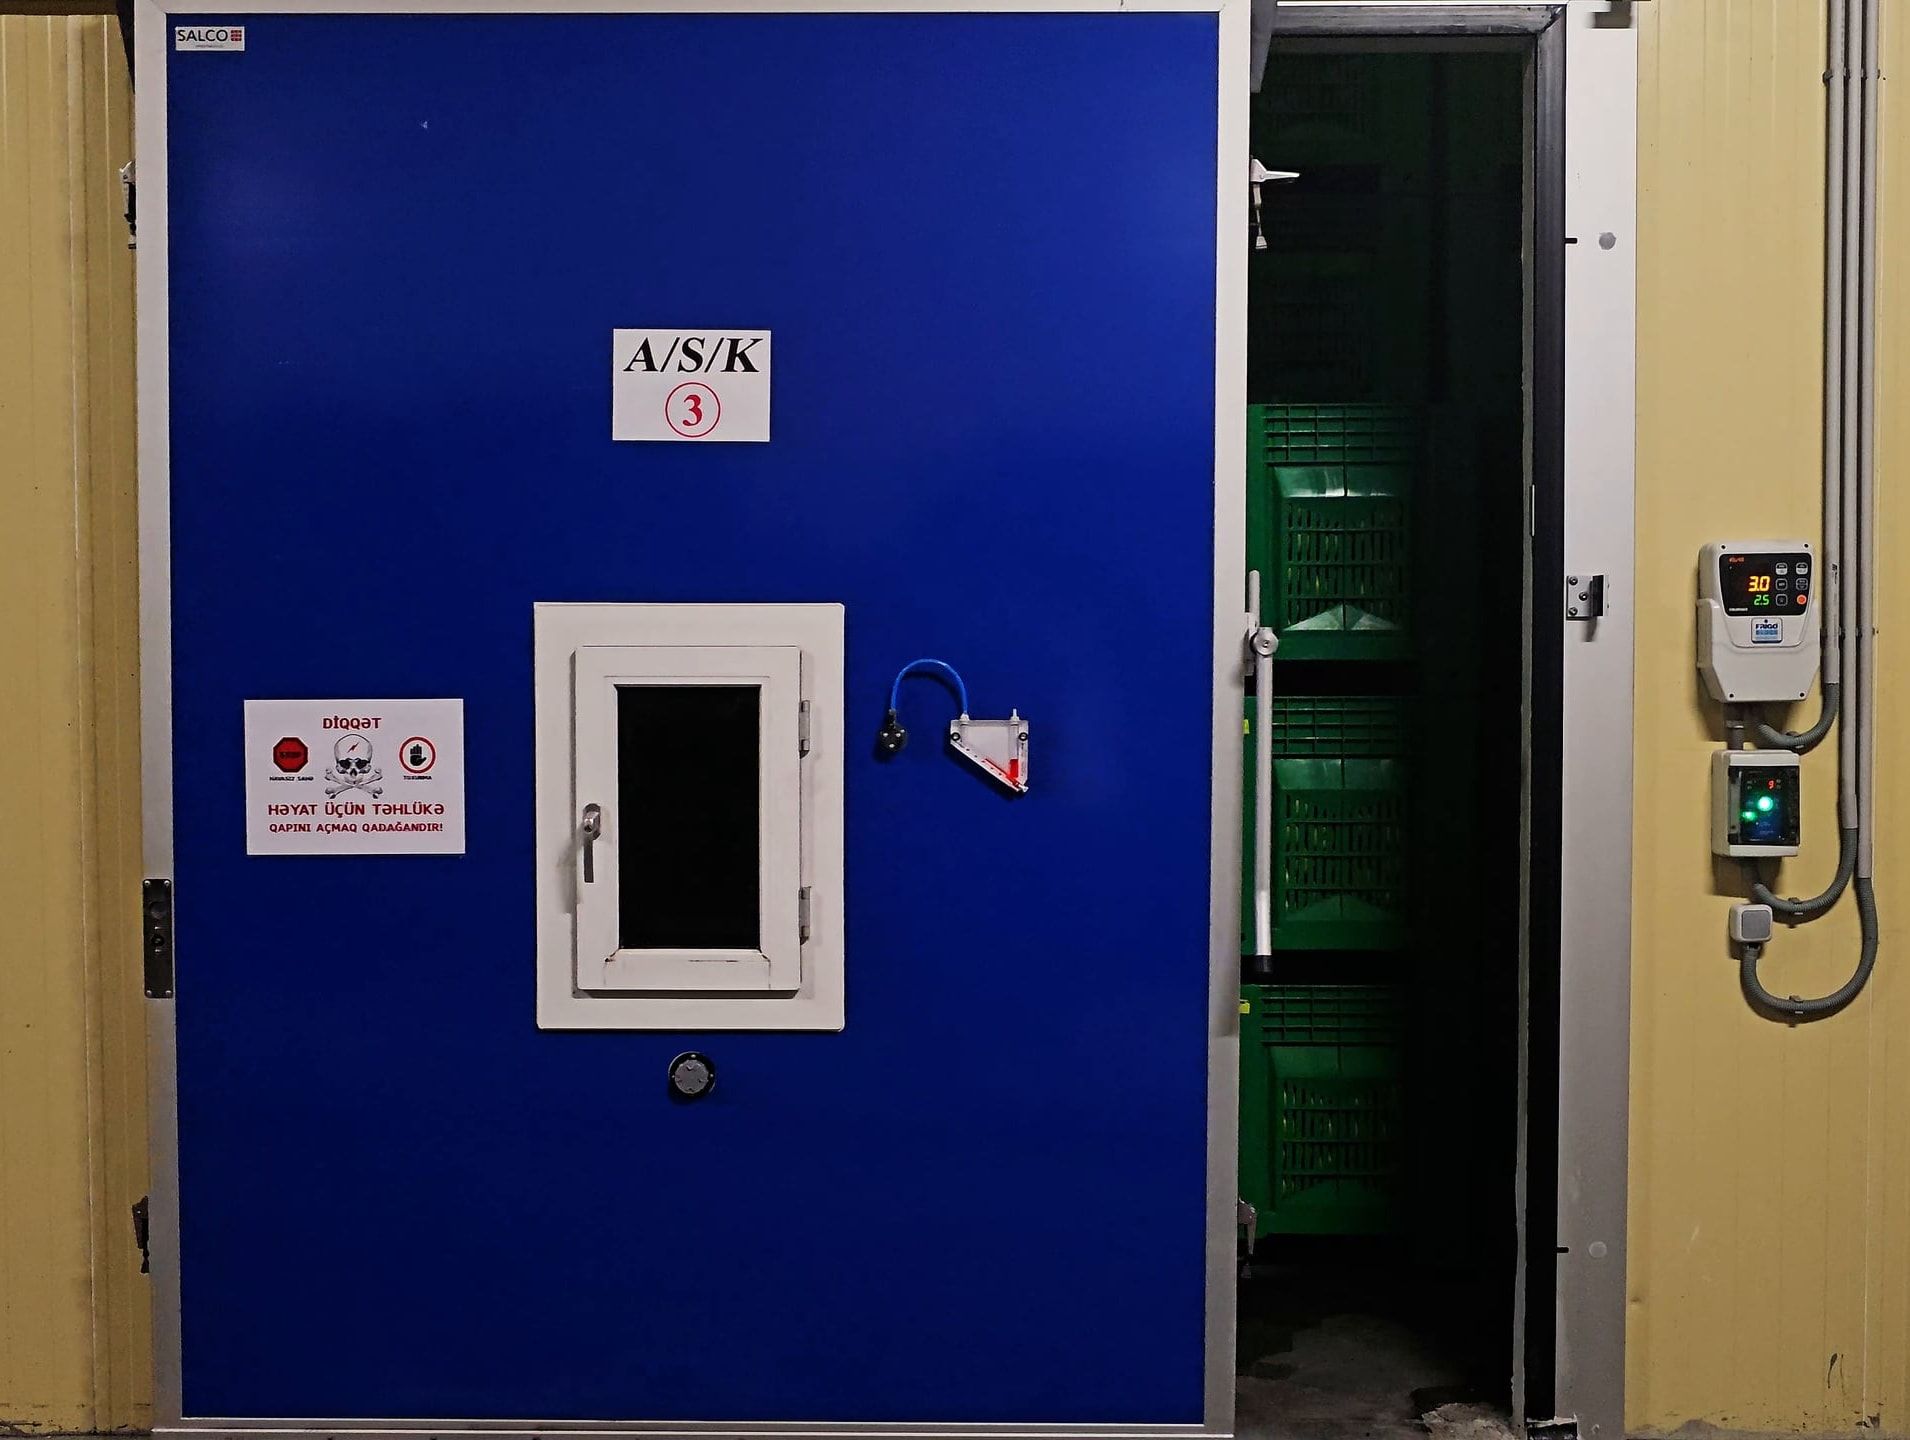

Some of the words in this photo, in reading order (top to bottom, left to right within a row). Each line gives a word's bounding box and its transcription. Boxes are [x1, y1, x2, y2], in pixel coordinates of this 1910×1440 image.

[177, 29, 228, 42] SALCO
[623, 337, 764, 373] A/S/K
[682, 394, 703, 426] 3
[1748, 575, 1770, 592] 3.0
[1753, 594, 1770, 606] 2.5
[322, 715, 382, 731] DİQQƏT
[267, 804, 318, 816] HƏYAT
[324, 802, 366, 818] ÜÇÜN
[372, 802, 445, 816] TƏHLÜKƏ
[269, 823, 312, 833] QAPINI
[316, 823, 358, 835] AÇMAQ
[362, 821, 444, 833] QADAĞANDIR!
